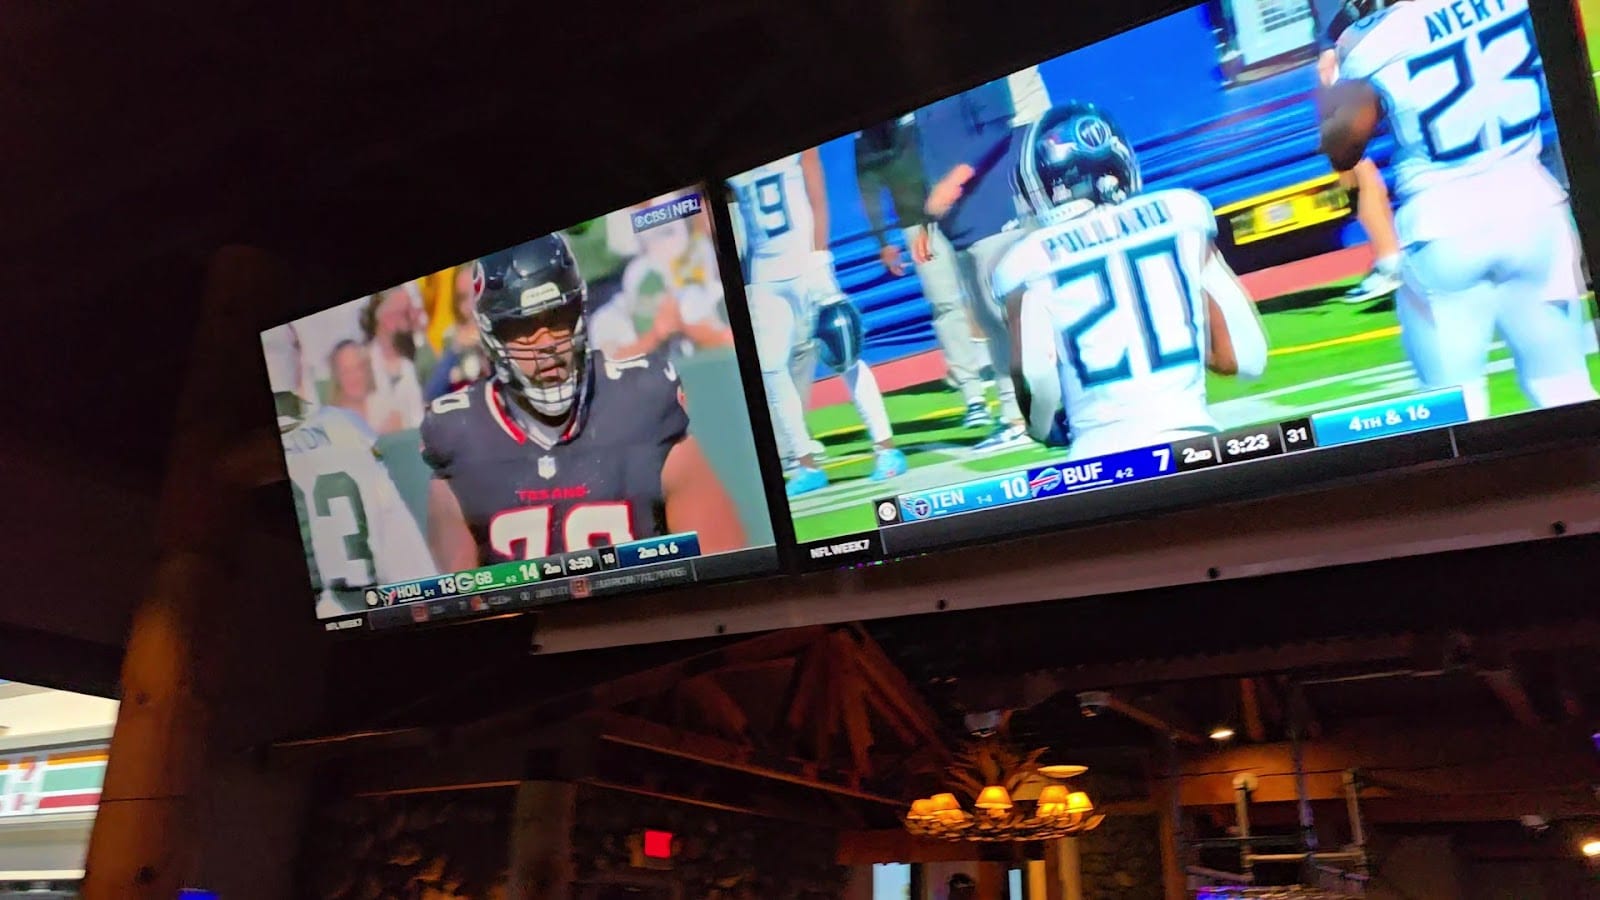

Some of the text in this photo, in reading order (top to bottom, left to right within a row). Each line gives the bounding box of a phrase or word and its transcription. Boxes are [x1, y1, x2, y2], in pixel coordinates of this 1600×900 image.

[1407, 9, 1544, 162] 23
[643, 207, 667, 226] CBS
[1053, 232, 1201, 388] 20
[930, 489, 965, 509] TEN
[1000, 477, 1028, 500] 10
[1062, 462, 1102, 485] BUF
[1115, 467, 1134, 479] 4-2
[1152, 448, 1170, 472] 7
[1226, 433, 1270, 455] 3:23
[1286, 427, 1308, 444] 31
[1348, 415, 1383, 432] 4TH
[1385, 410, 1401, 425] &
[1406, 403, 1431, 421] 16
[397, 583, 421, 598] HOU
[438, 577, 456, 594] 13
[475, 571, 493, 585] GB
[519, 563, 539, 581] 14
[568, 556, 593, 571] 3:50
[669, 541, 679, 554] 6
